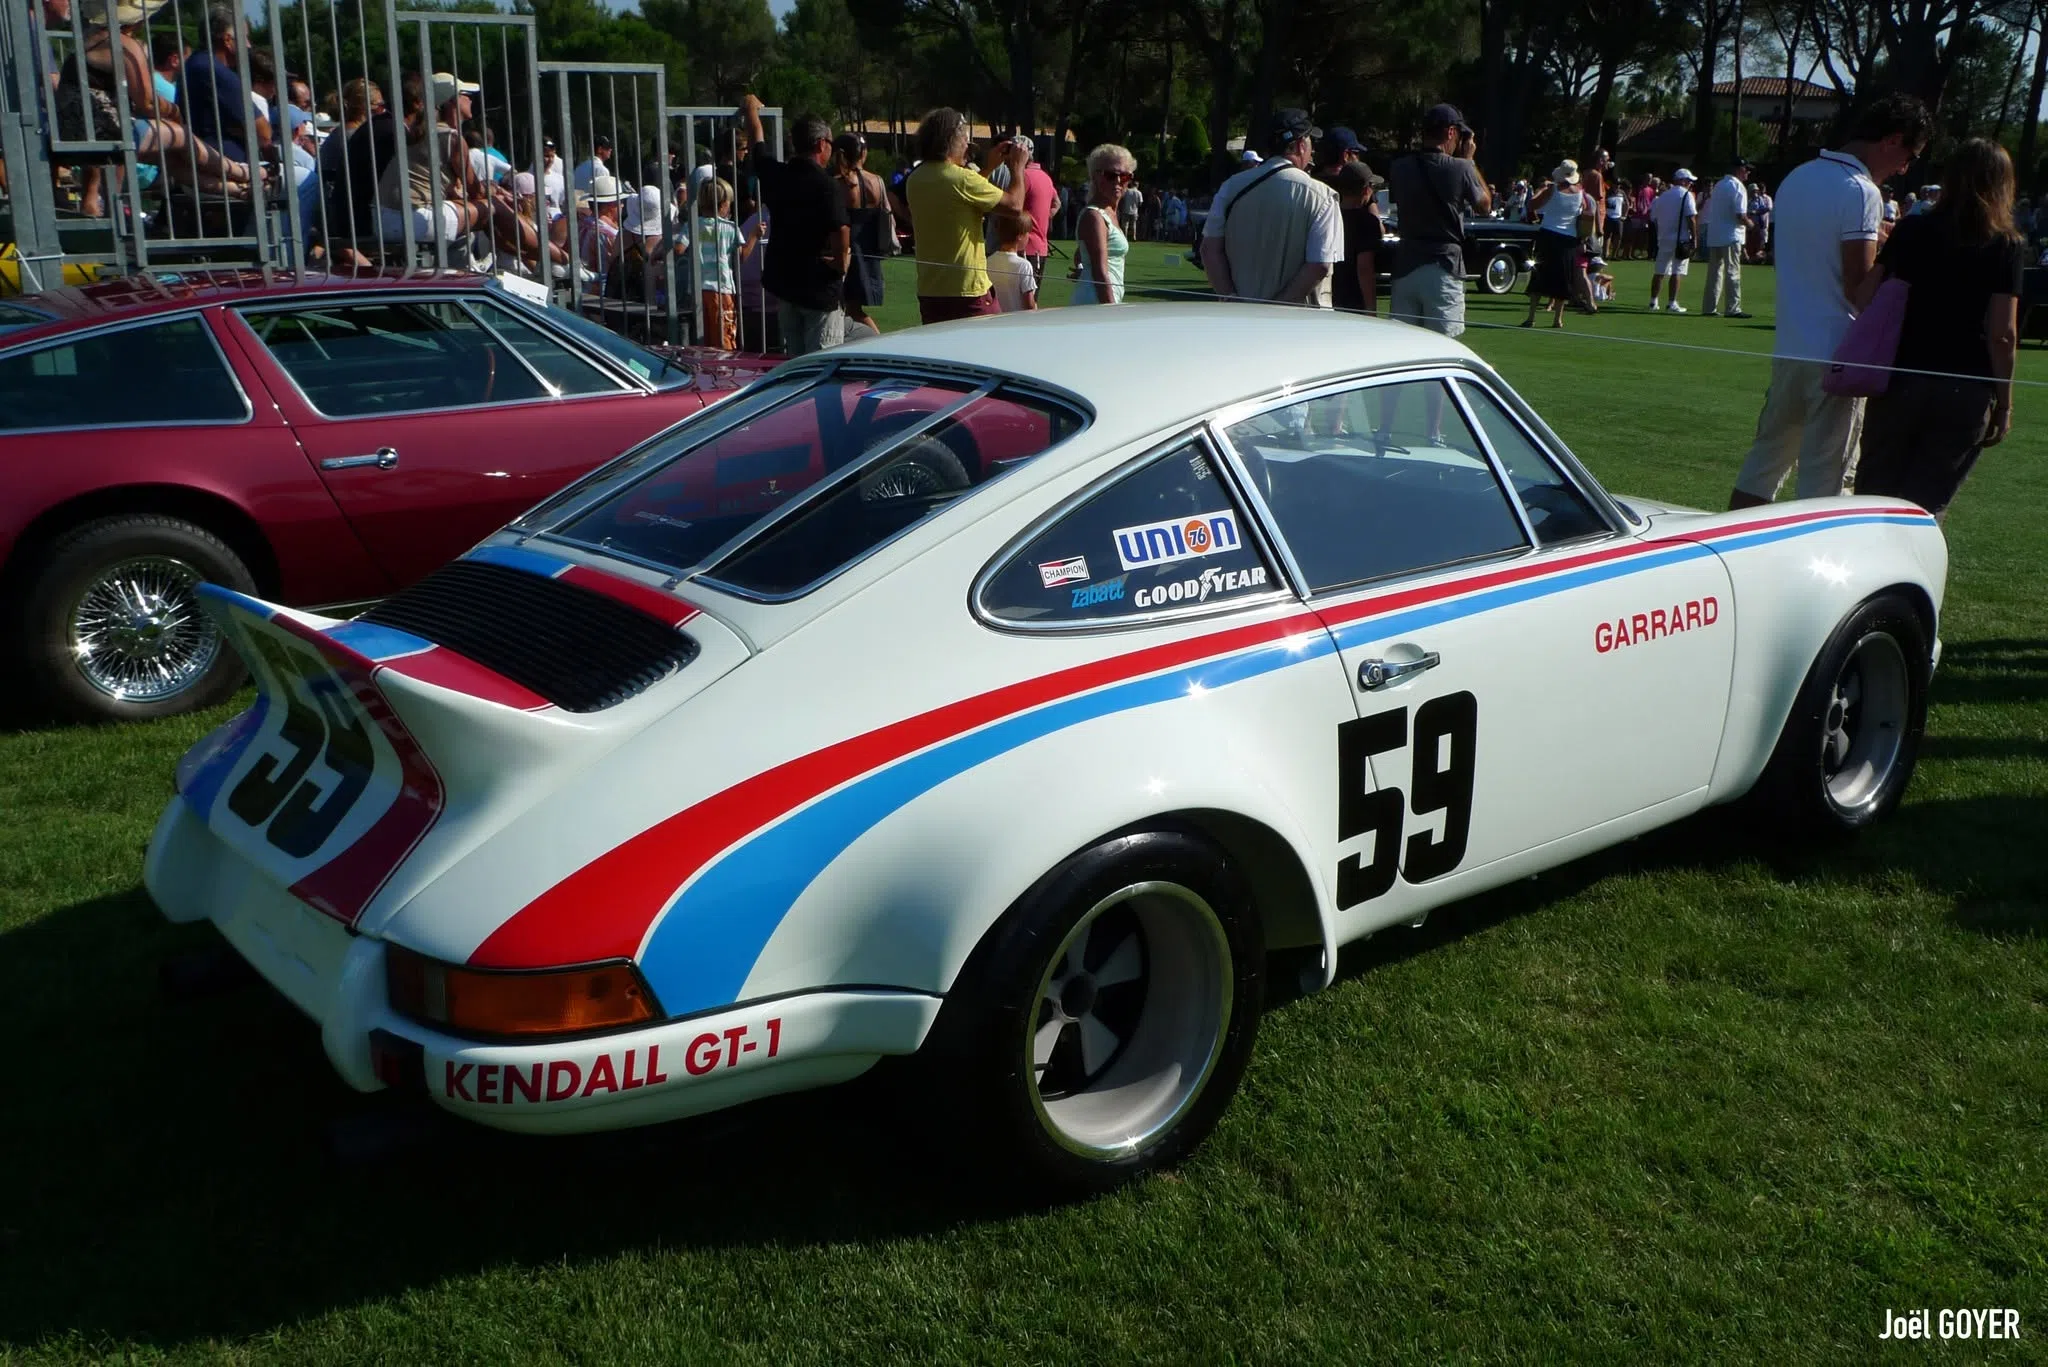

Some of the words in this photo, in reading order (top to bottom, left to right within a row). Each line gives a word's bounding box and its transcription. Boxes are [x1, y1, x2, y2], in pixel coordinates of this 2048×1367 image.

[1118, 516, 1237, 563] UNION
[1188, 525, 1207, 547] 76
[1044, 564, 1085, 580] CHAMPION
[1595, 596, 1719, 653] GARRARD
[1337, 690, 1478, 912] 59
[445, 1044, 668, 1104] KENDALL
[684, 1017, 782, 1077] GT-1
